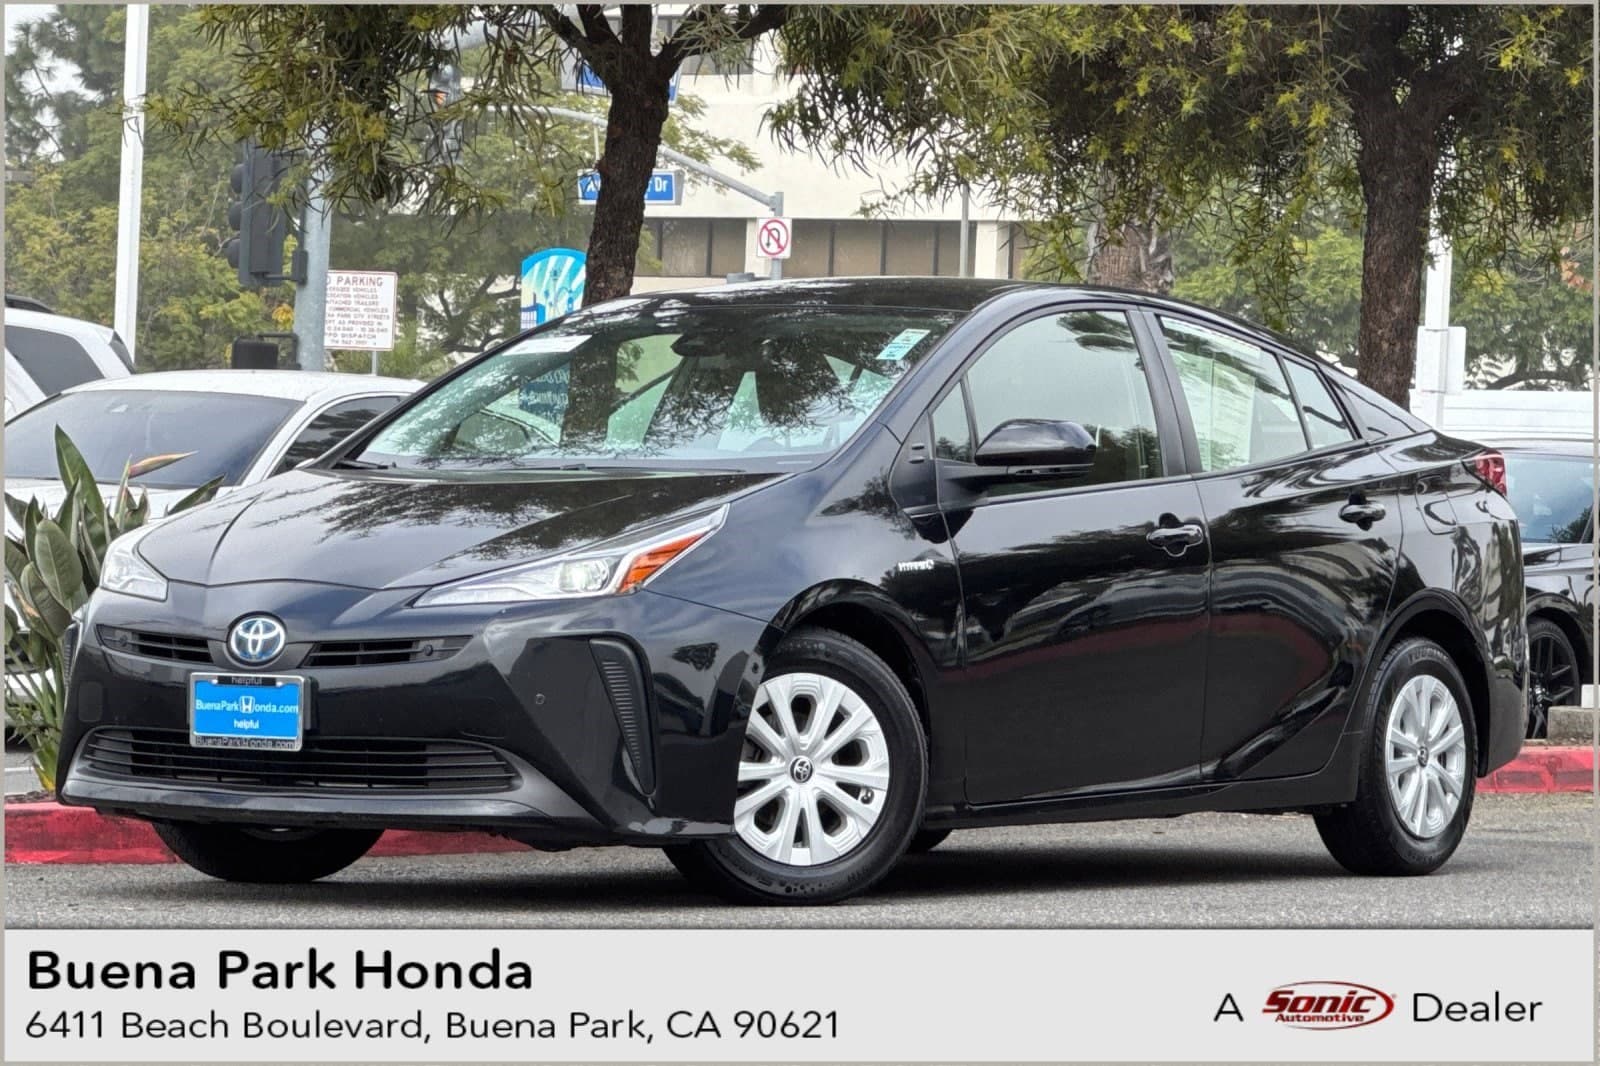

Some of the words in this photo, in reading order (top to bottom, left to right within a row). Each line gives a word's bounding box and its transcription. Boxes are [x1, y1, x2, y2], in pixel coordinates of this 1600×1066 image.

[654, 176, 668, 192] Dr
[336, 275, 384, 287] PARKING
[231, 676, 263, 685] helpful
[233, 718, 260, 730] helpful
